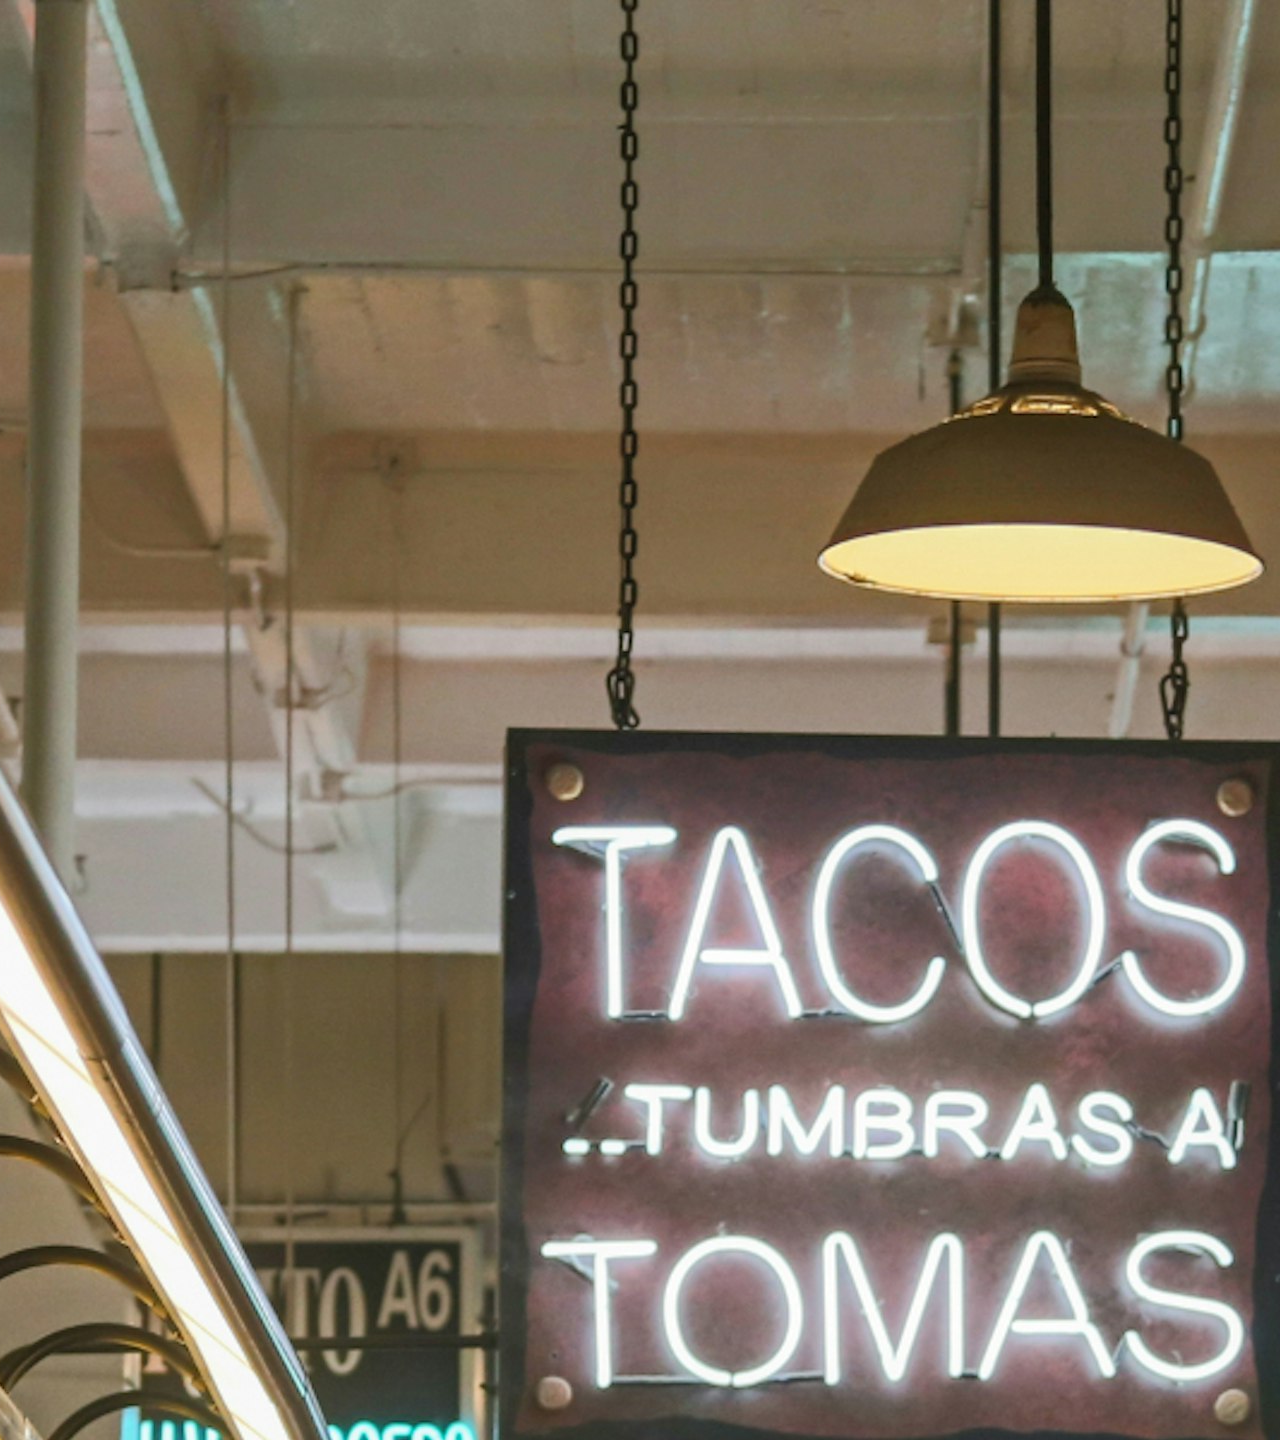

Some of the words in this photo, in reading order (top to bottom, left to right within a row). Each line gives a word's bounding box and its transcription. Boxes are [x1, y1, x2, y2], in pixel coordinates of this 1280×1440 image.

[551, 818, 1248, 1023] TACOS
[1167, 1086, 1237, 1170] A
[376, 1249, 454, 1333] A6
[540, 1230, 1248, 1389] TOMAS
